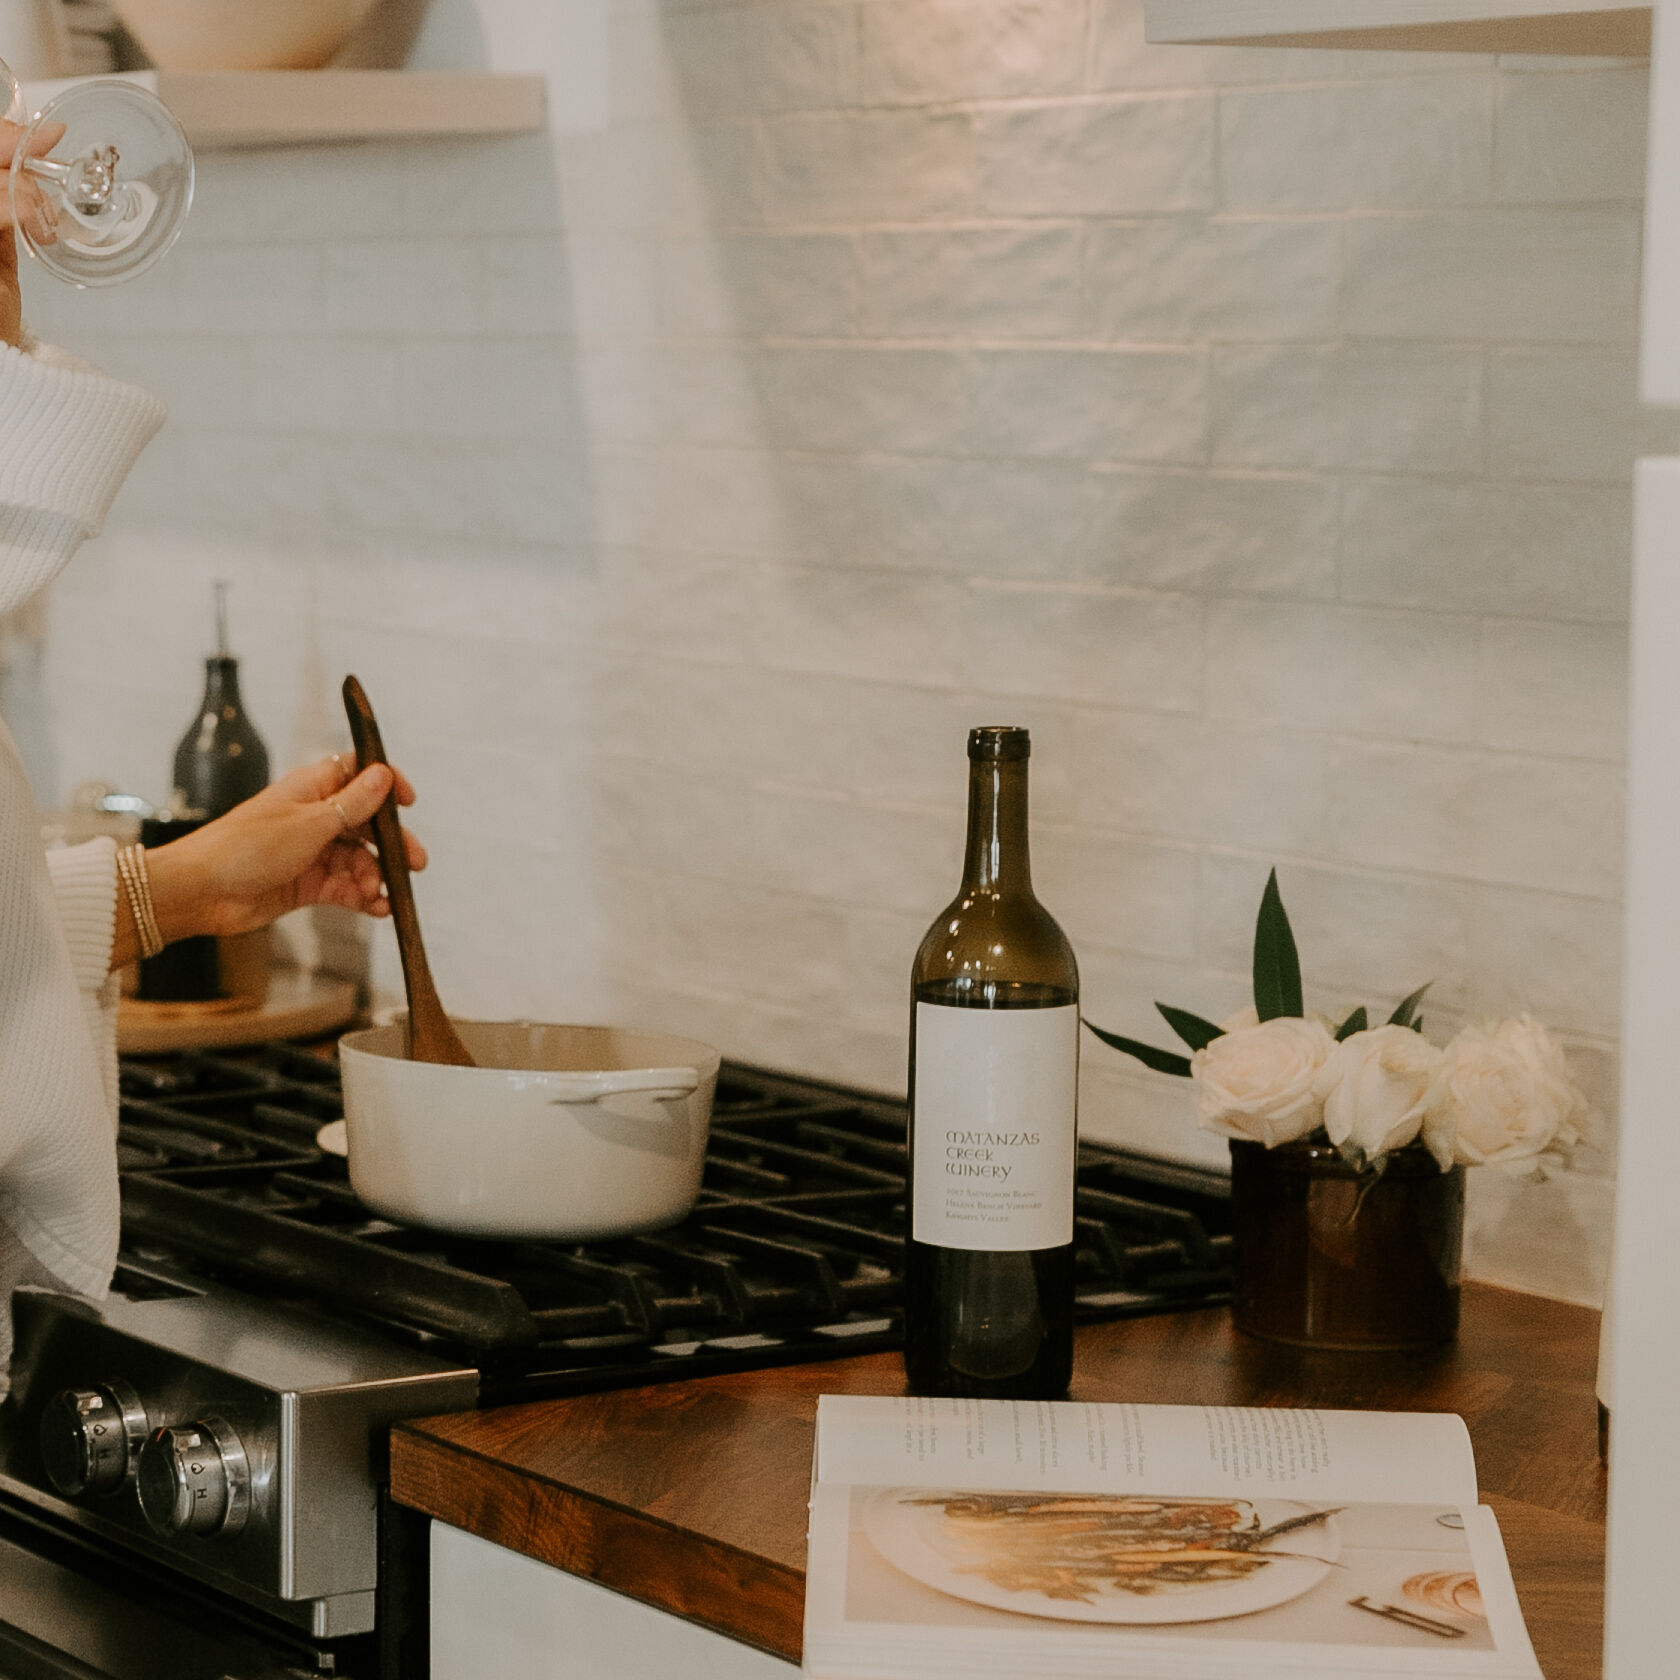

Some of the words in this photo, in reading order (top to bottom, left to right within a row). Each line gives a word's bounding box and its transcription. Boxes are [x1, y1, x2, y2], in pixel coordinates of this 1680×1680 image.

[945, 1130, 1040, 1146] MATANZAS
[945, 1146, 994, 1161] CREEK
[945, 1162, 1012, 1184] WINERY
